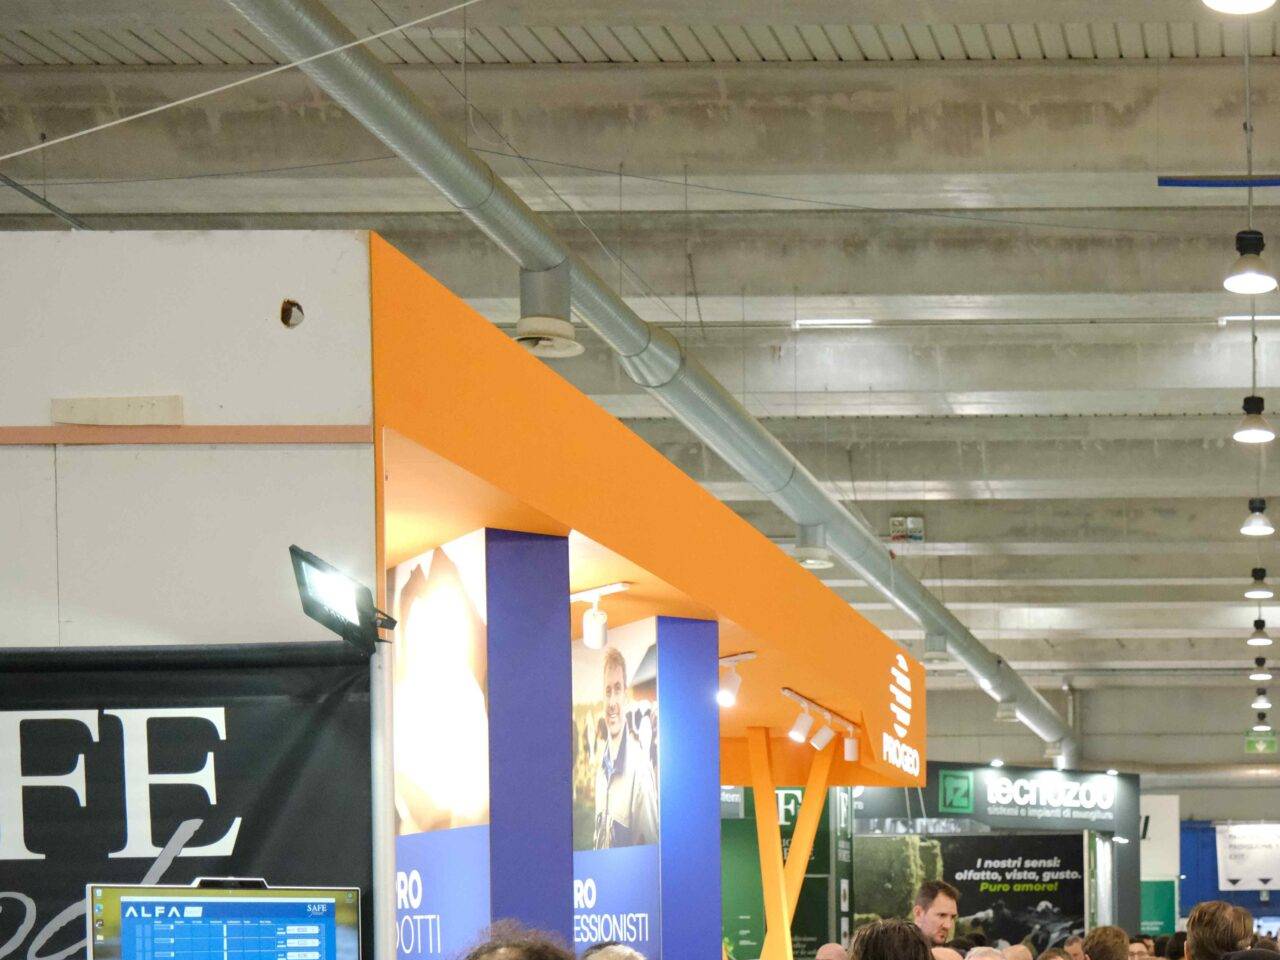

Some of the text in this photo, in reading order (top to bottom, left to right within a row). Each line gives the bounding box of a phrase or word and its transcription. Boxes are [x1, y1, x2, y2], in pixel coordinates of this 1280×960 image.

[983, 857, 1022, 868] nostri
[1023, 857, 1061, 868] sensi:
[955, 869, 1082, 882] olfatto, vista, gusto.
[396, 869, 422, 909] RO
[980, 882, 1059, 892] Puro amore!
[125, 906, 180, 917] ALFA
[307, 904, 328, 912] SAFE
[574, 913, 648, 942] ESSIONISTI
[396, 914, 441, 954] OTTI
